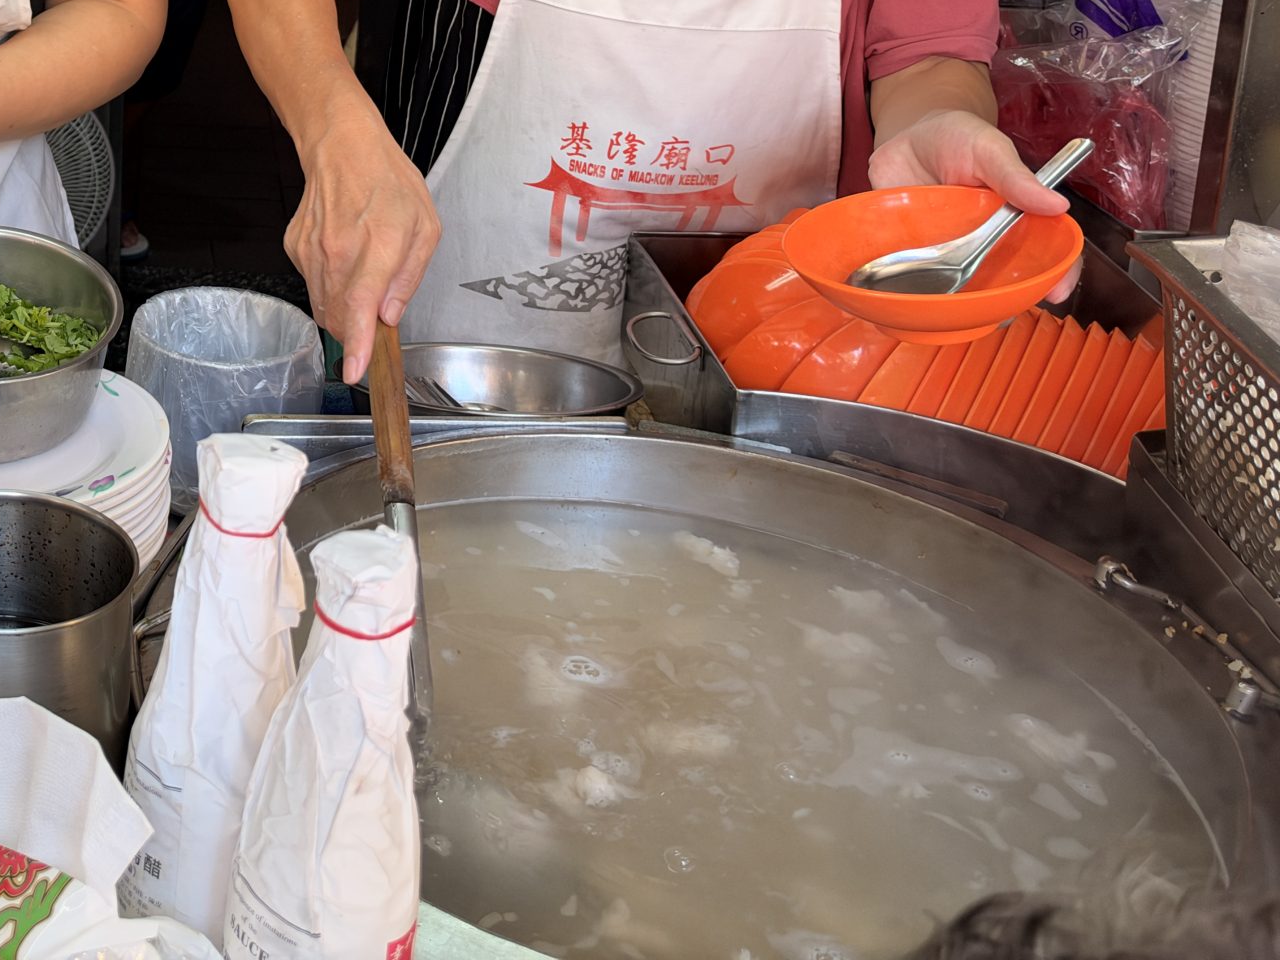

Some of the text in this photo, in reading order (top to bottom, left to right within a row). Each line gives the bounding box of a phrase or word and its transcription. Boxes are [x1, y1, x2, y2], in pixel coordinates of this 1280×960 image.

[560, 121, 735, 171] 基隆廟口
[569, 159, 719, 186] SNACKS OF MIAO-KOW KEELUNG
